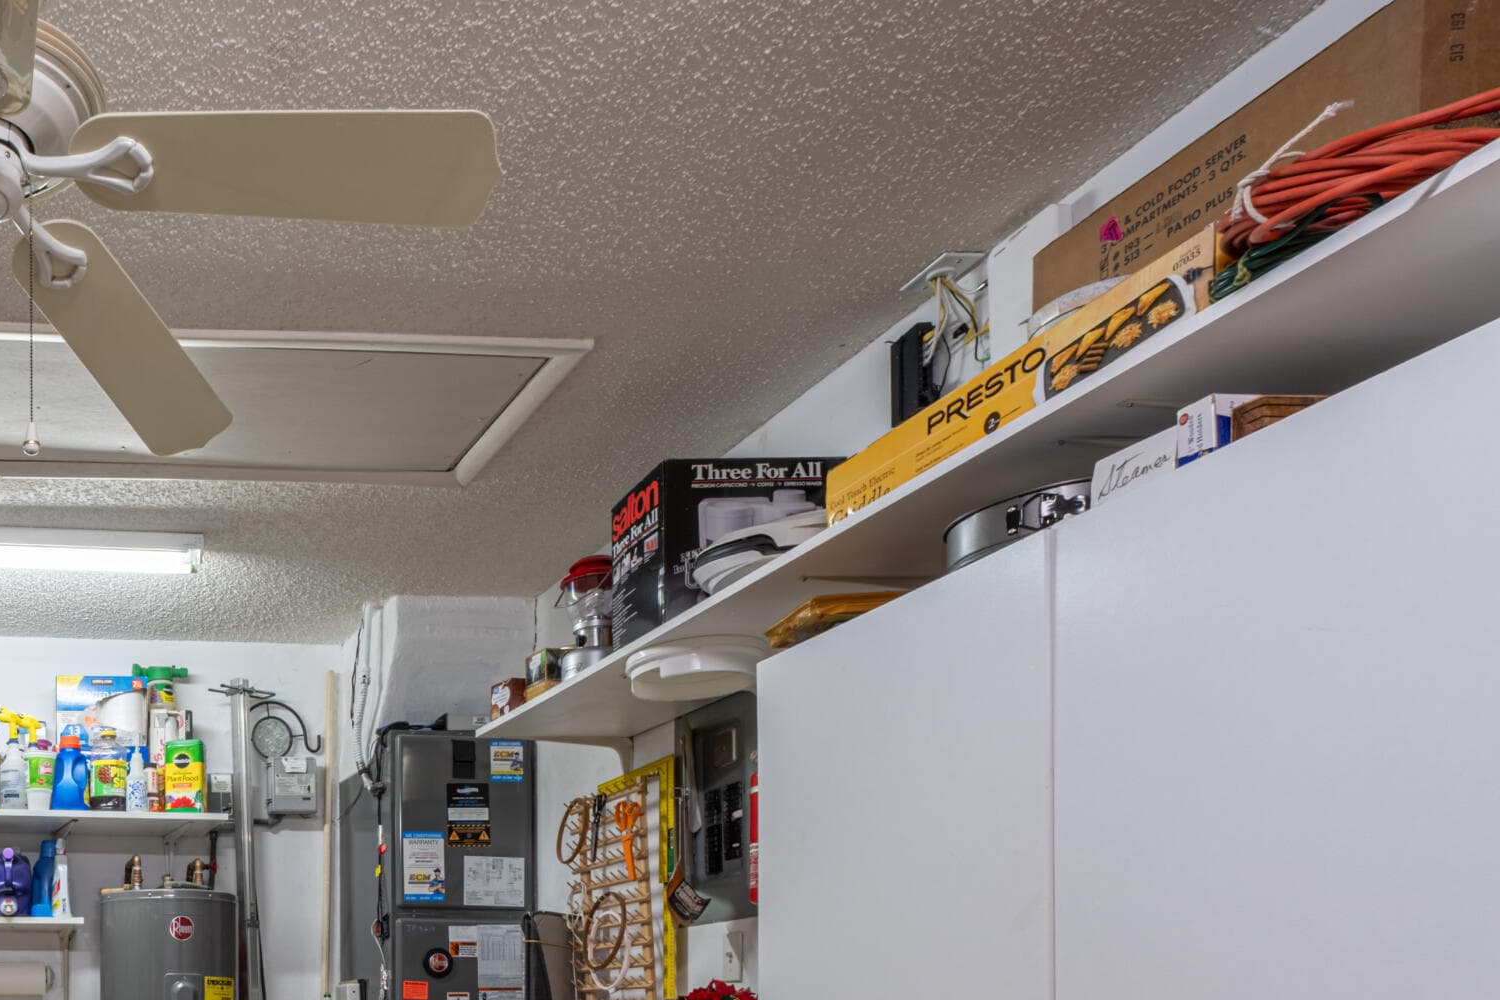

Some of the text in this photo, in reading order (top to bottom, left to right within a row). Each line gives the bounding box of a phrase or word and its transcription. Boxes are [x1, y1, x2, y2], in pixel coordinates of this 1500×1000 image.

[1135, 191, 1164, 217] COLD
[1168, 167, 1201, 194] FOOD
[1205, 134, 1247, 170] SERVER
[1208, 170, 1216, 182] 3
[1220, 151, 1247, 172] QTS.
[1167, 209, 1201, 238] PATIO
[1205, 187, 1233, 212] PLUS
[927, 347, 1046, 435] PRESTO
[691, 461, 821, 481] Three For All
[869, 467, 896, 488] Electric
[613, 480, 659, 542] salton
[613, 507, 659, 557] Three For All
